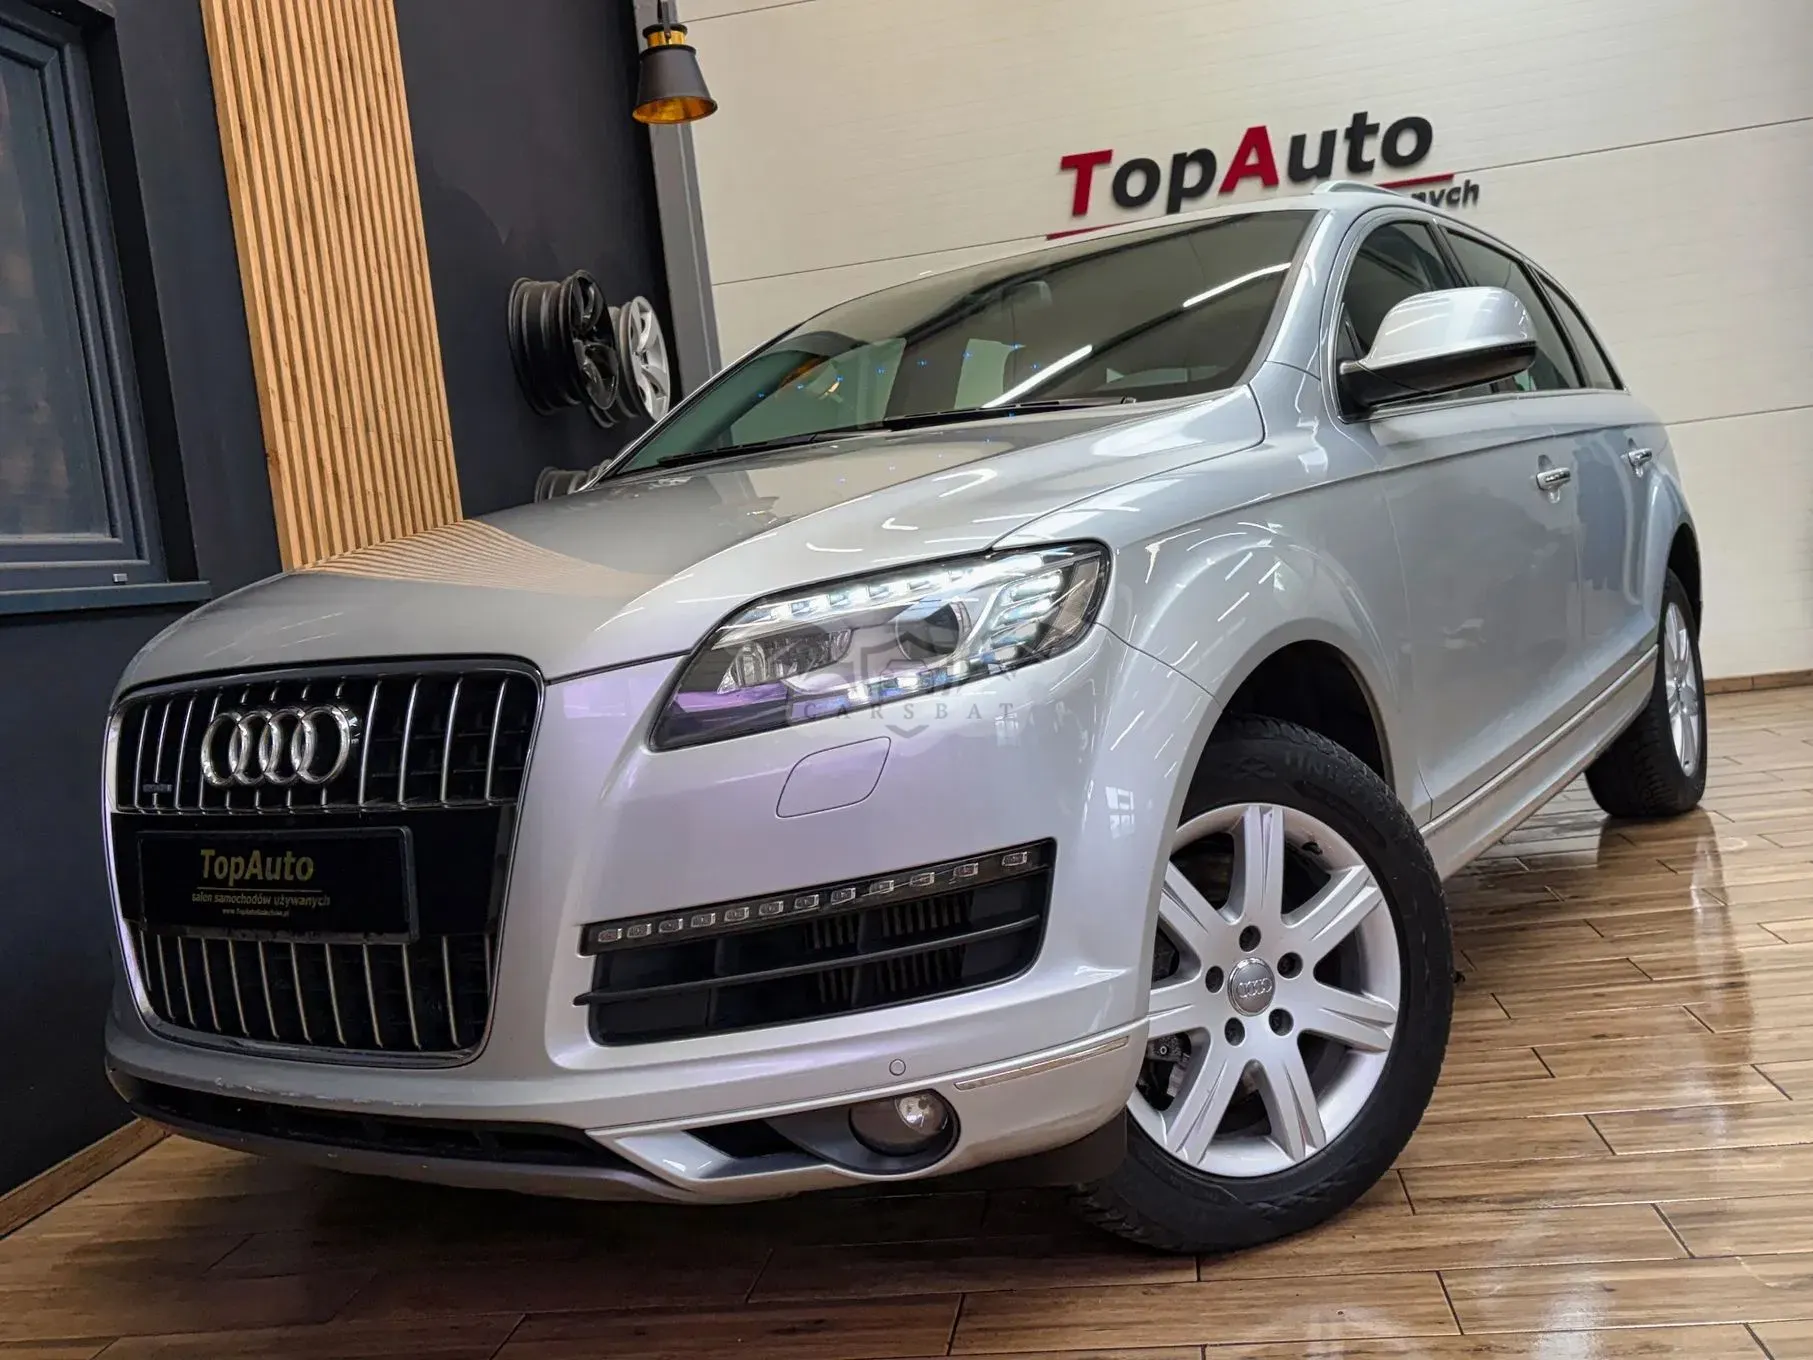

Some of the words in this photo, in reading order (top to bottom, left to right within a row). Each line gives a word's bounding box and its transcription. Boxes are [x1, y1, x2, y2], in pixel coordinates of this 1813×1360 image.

[1060, 111, 1433, 217] TopAuto
[200, 848, 315, 887] TopAuto
[191, 891, 213, 903] salon
[214, 892, 271, 905] samochodów
[273, 894, 331, 909] używanych
